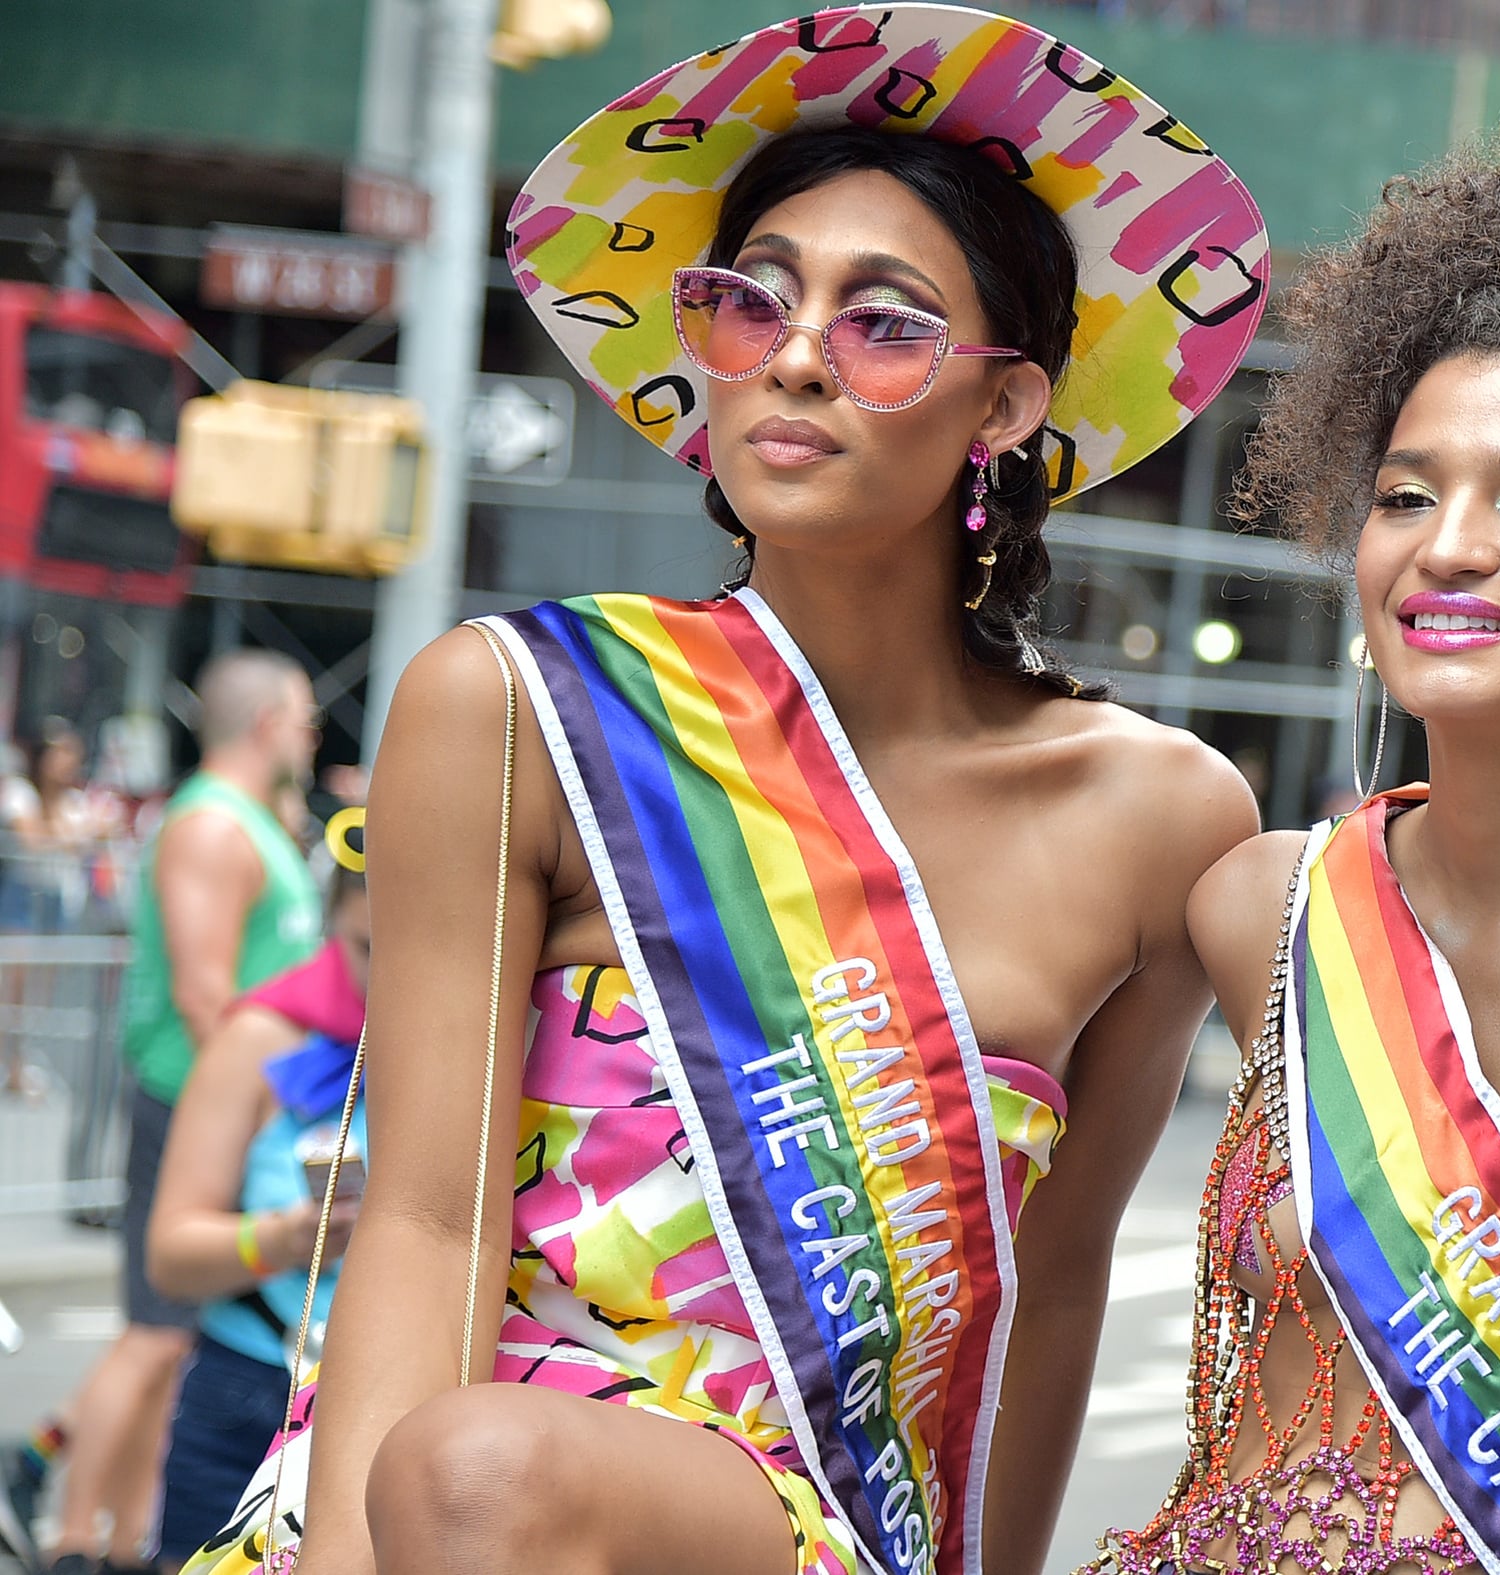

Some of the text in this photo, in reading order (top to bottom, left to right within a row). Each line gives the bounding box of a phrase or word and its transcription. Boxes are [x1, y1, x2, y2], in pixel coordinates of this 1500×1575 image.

[741, 1033, 839, 1169] THE
[791, 1184, 890, 1351] CAST
[842, 1358, 883, 1428] OF
[811, 956, 961, 1450] GRAND MARSHAL
[1388, 1271, 1493, 1412] THE
